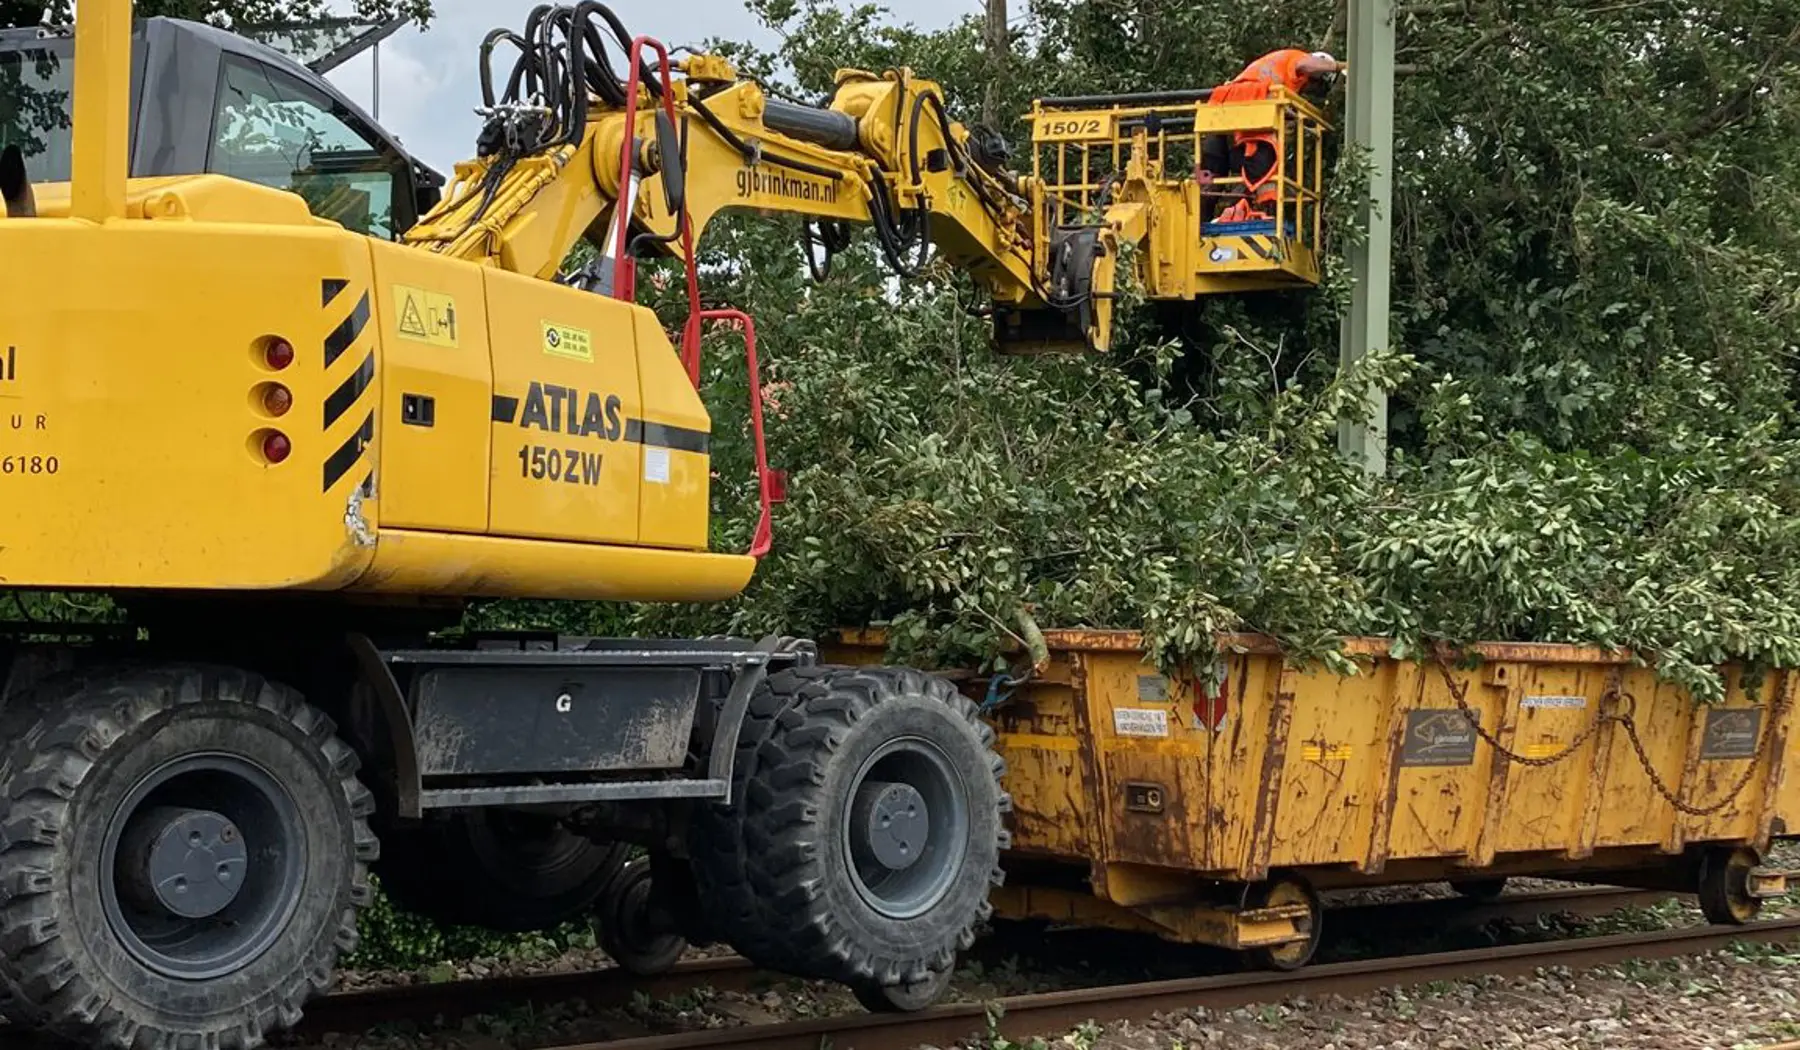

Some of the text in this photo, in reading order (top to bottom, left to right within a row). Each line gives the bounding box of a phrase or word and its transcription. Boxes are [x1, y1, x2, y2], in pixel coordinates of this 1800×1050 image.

[1042, 120, 1101, 136] 150/2
[736, 165, 836, 204] gjbrinkman.nl
[520, 381, 621, 442] ATLAS
[2, 456, 59, 474] 6180
[518, 444, 603, 486] 150ZW
[556, 694, 571, 712] G
